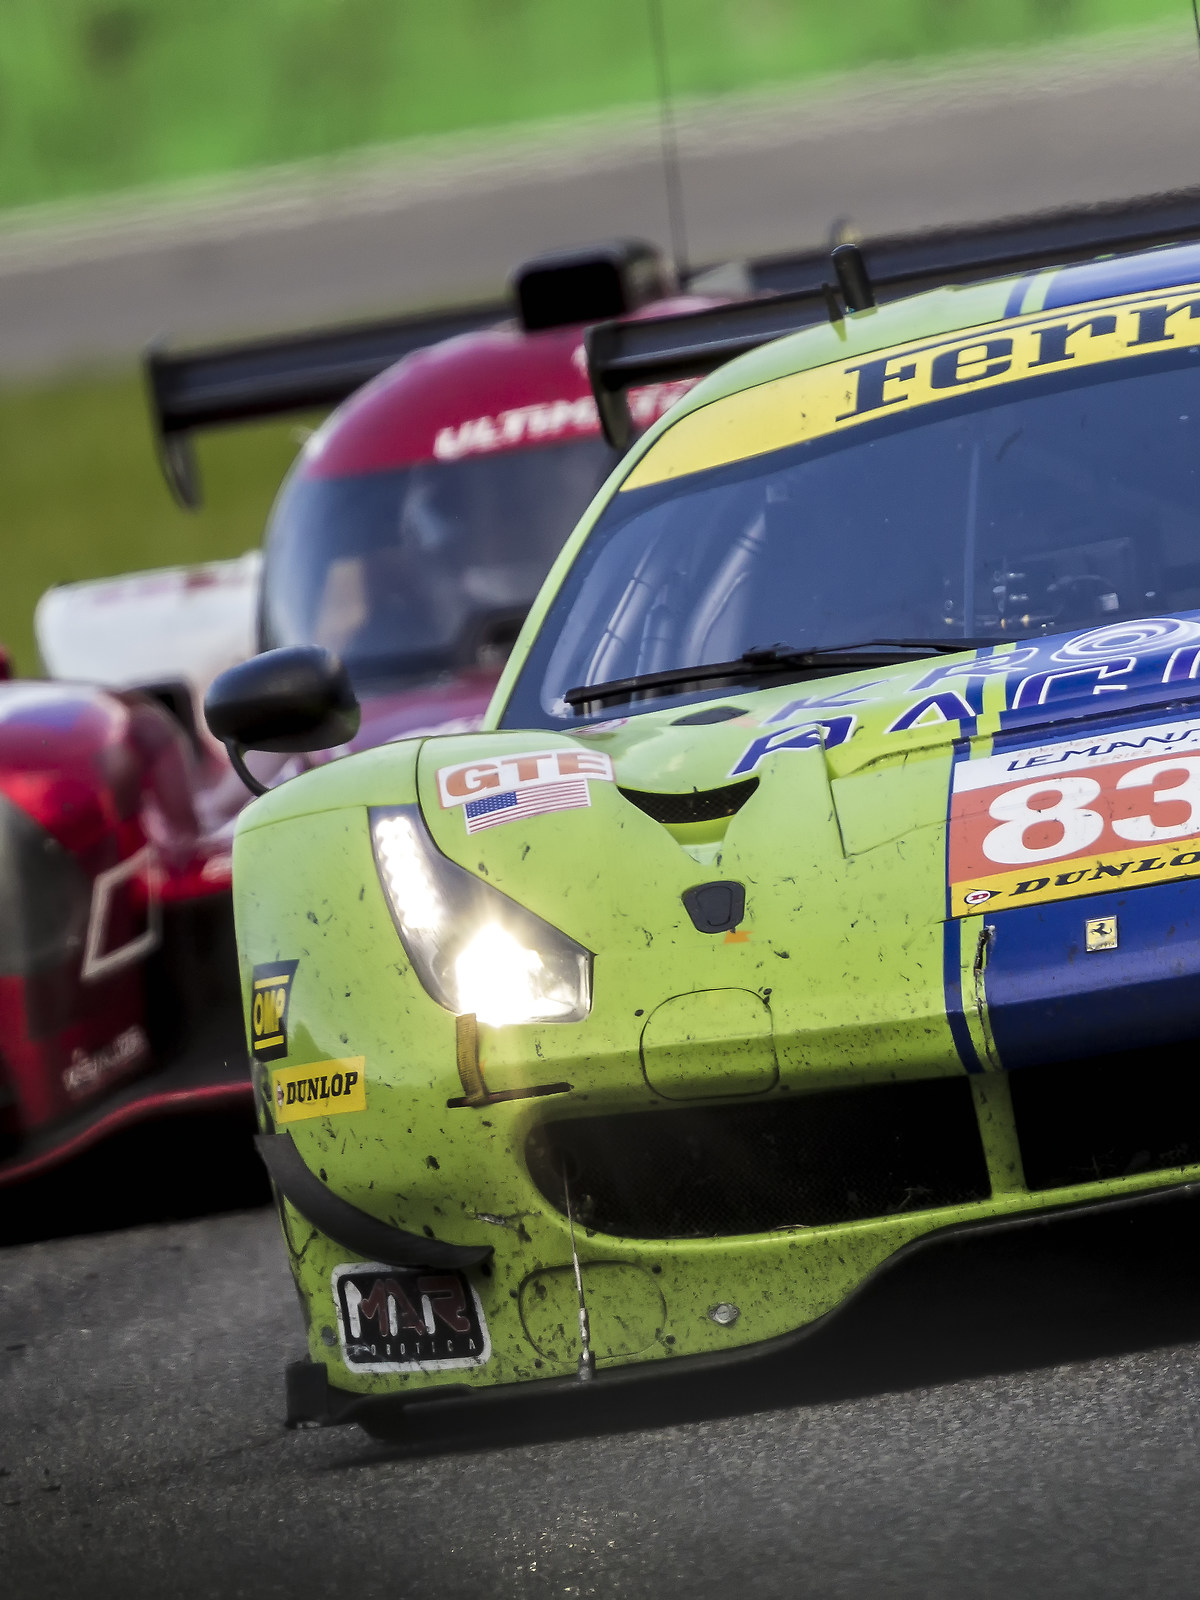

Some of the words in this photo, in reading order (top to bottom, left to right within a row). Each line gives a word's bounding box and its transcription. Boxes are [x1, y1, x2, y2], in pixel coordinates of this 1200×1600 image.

[445, 752, 607, 797] GTE
[253, 987, 286, 1036] OMP
[286, 1071, 359, 1105] DUNLOP
